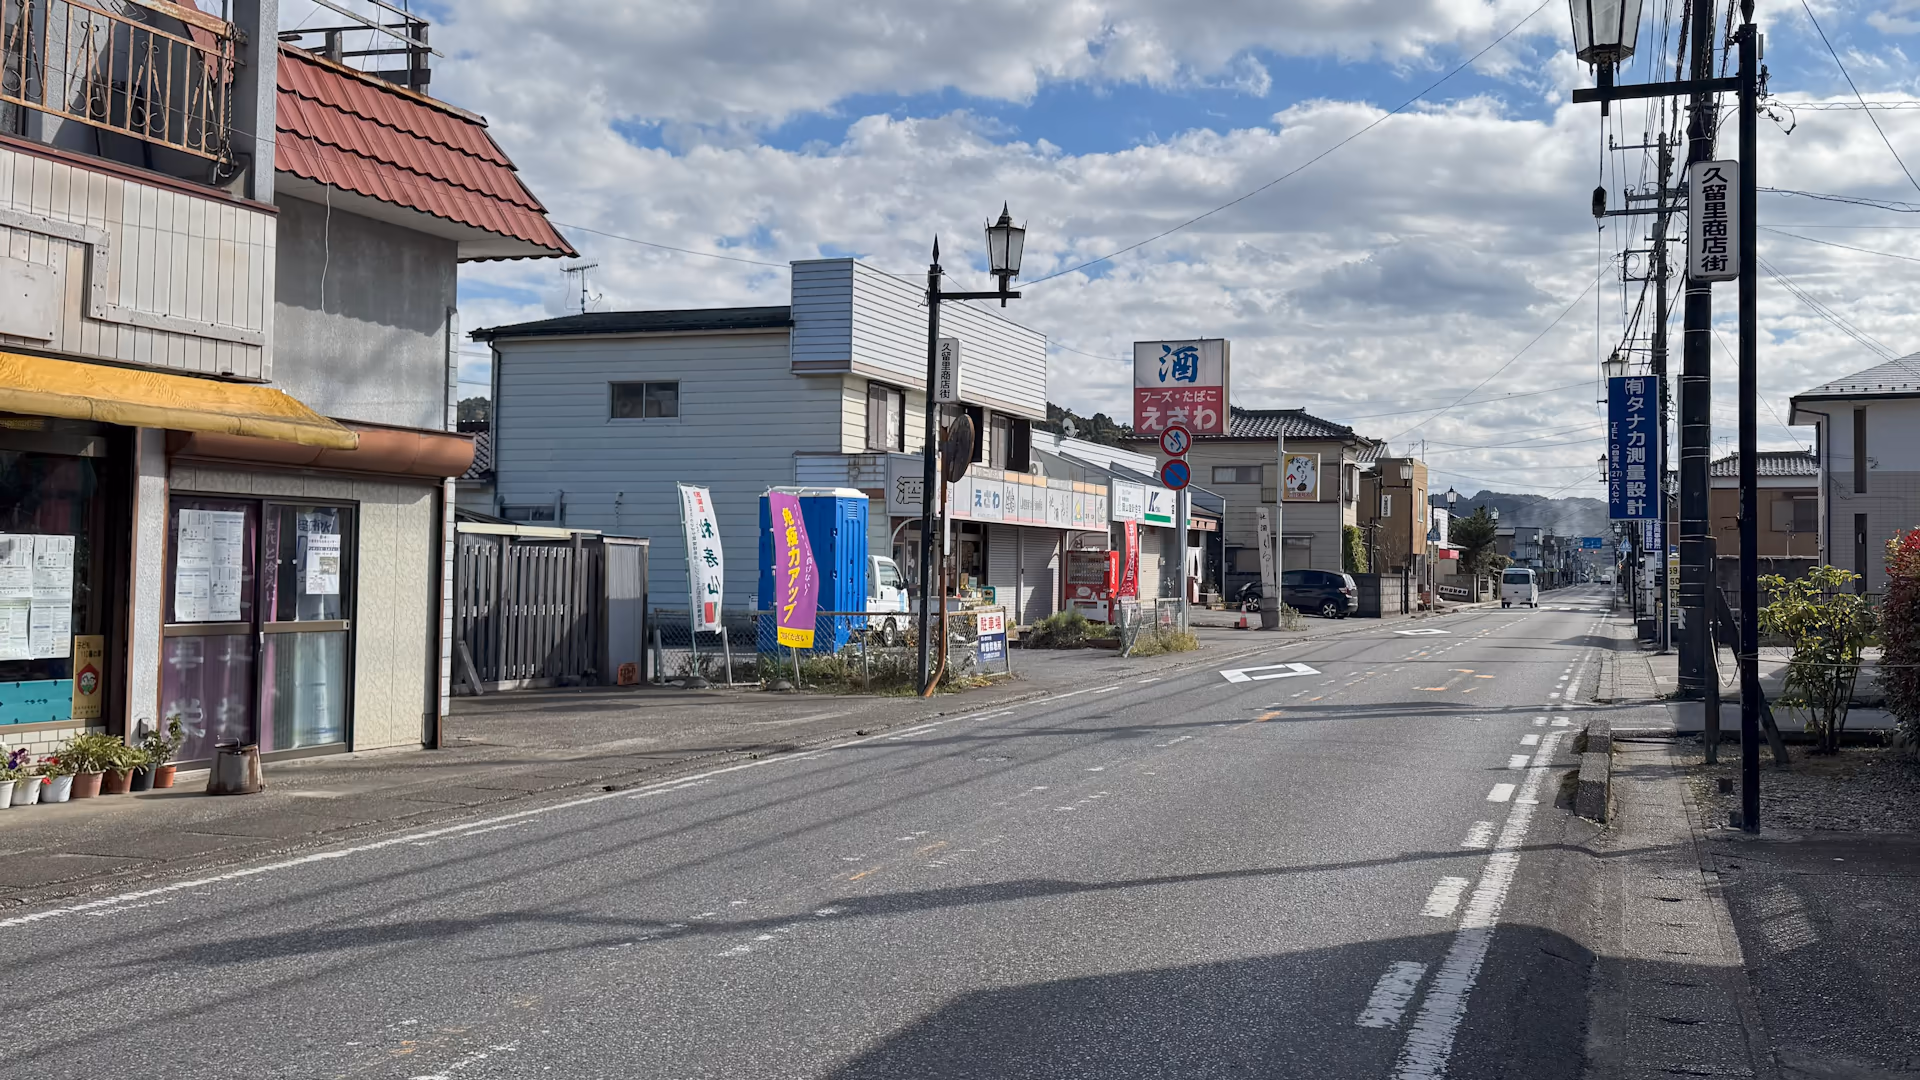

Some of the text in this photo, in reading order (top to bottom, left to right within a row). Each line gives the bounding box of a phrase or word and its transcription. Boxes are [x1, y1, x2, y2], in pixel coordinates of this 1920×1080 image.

[1701, 167, 1728, 272] 久留里商店街
[939, 342, 951, 399] 久留里商店街
[1158, 344, 1199, 383] 酒
[1140, 390, 1217, 404] フーズ・たばこ
[1140, 405, 1217, 431] えざわ
[1611, 421, 1619, 440] TEL
[781, 507, 801, 624] 免疫力アップ
[980, 616, 1002, 632] 駐車場
